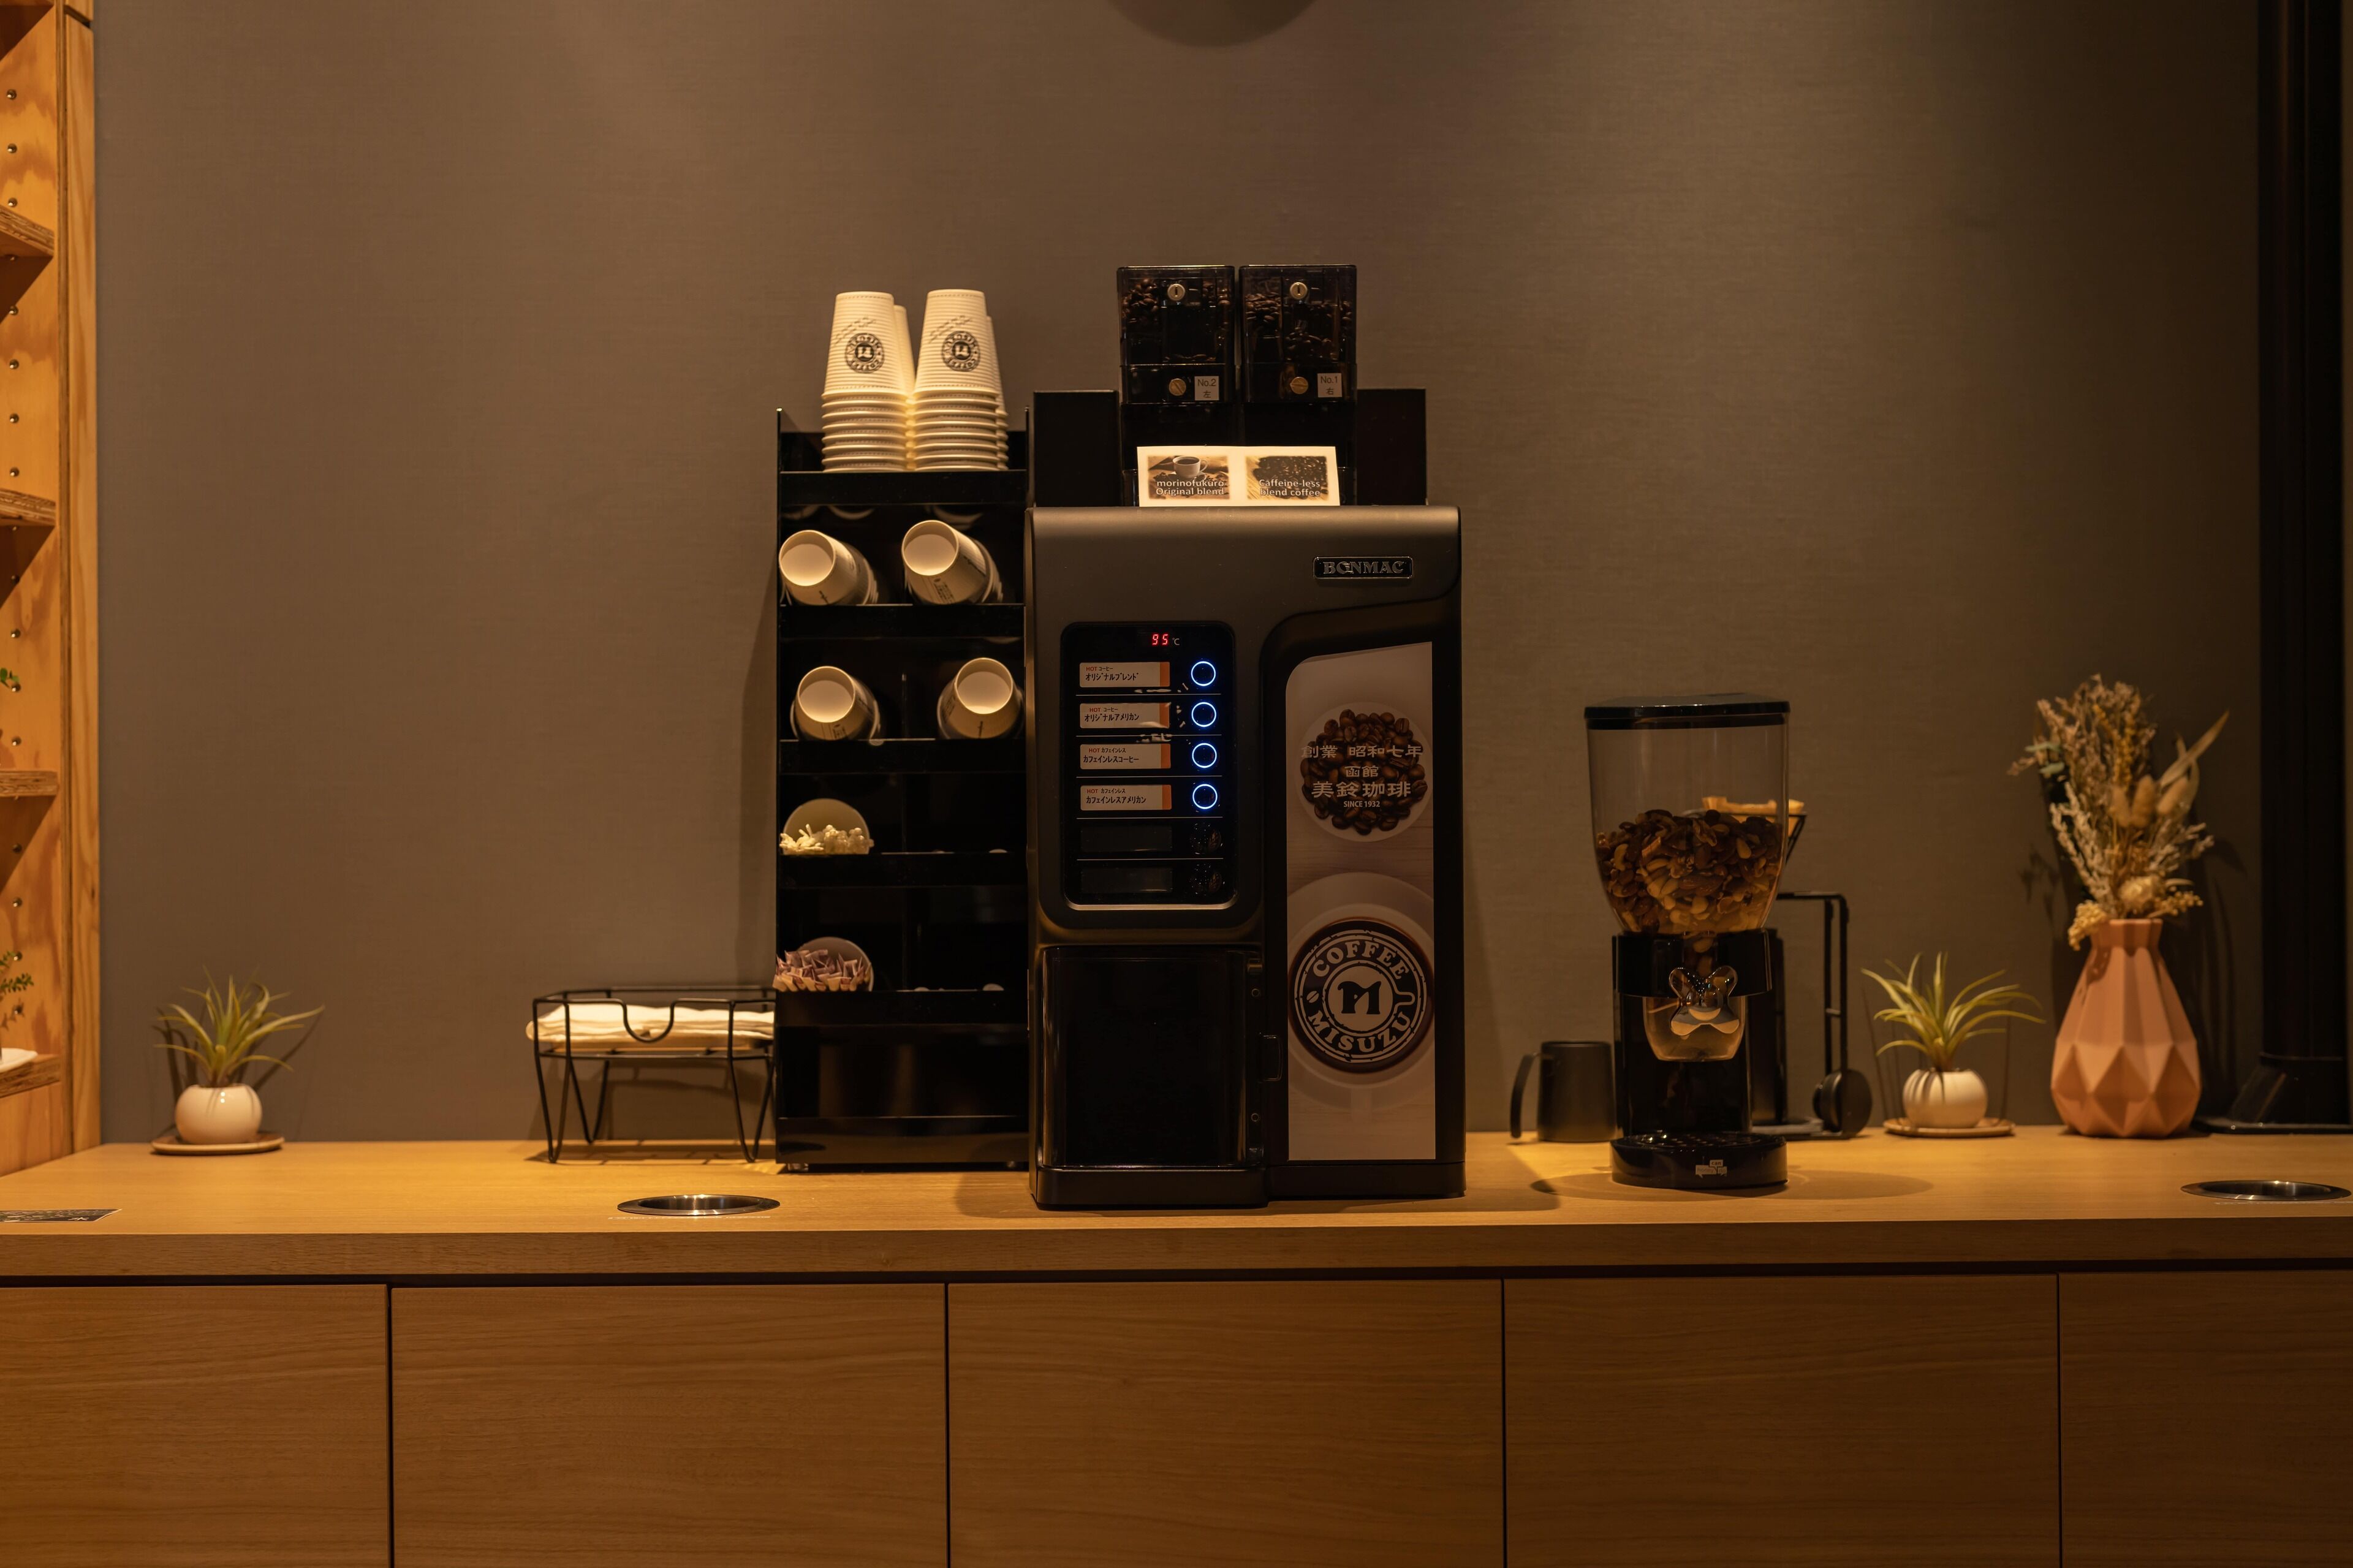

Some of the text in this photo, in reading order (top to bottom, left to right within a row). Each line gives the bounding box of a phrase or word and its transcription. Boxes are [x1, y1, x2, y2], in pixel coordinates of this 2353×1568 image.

[1197, 378, 1216, 387] No.2
[1320, 376, 1338, 384] No.1
[1157, 479, 1224, 487] morinofukuro
[1156, 488, 1194, 496] Original
[1260, 488, 1320, 497] blend coffee
[1322, 561, 1405, 574] BONMAC
[1152, 634, 1169, 645] 95
[1302, 744, 1423, 758] 創業 昭和七年
[1083, 755, 1139, 763] カフェインレスコーヒー
[1344, 765, 1379, 778] 函館
[1311, 781, 1411, 798] 美鈴珈琲
[1086, 796, 1146, 805] カフェインレスアメリカン
[1313, 940, 1409, 980] COFFEE
[1308, 1010, 1411, 1053] MISUZU
